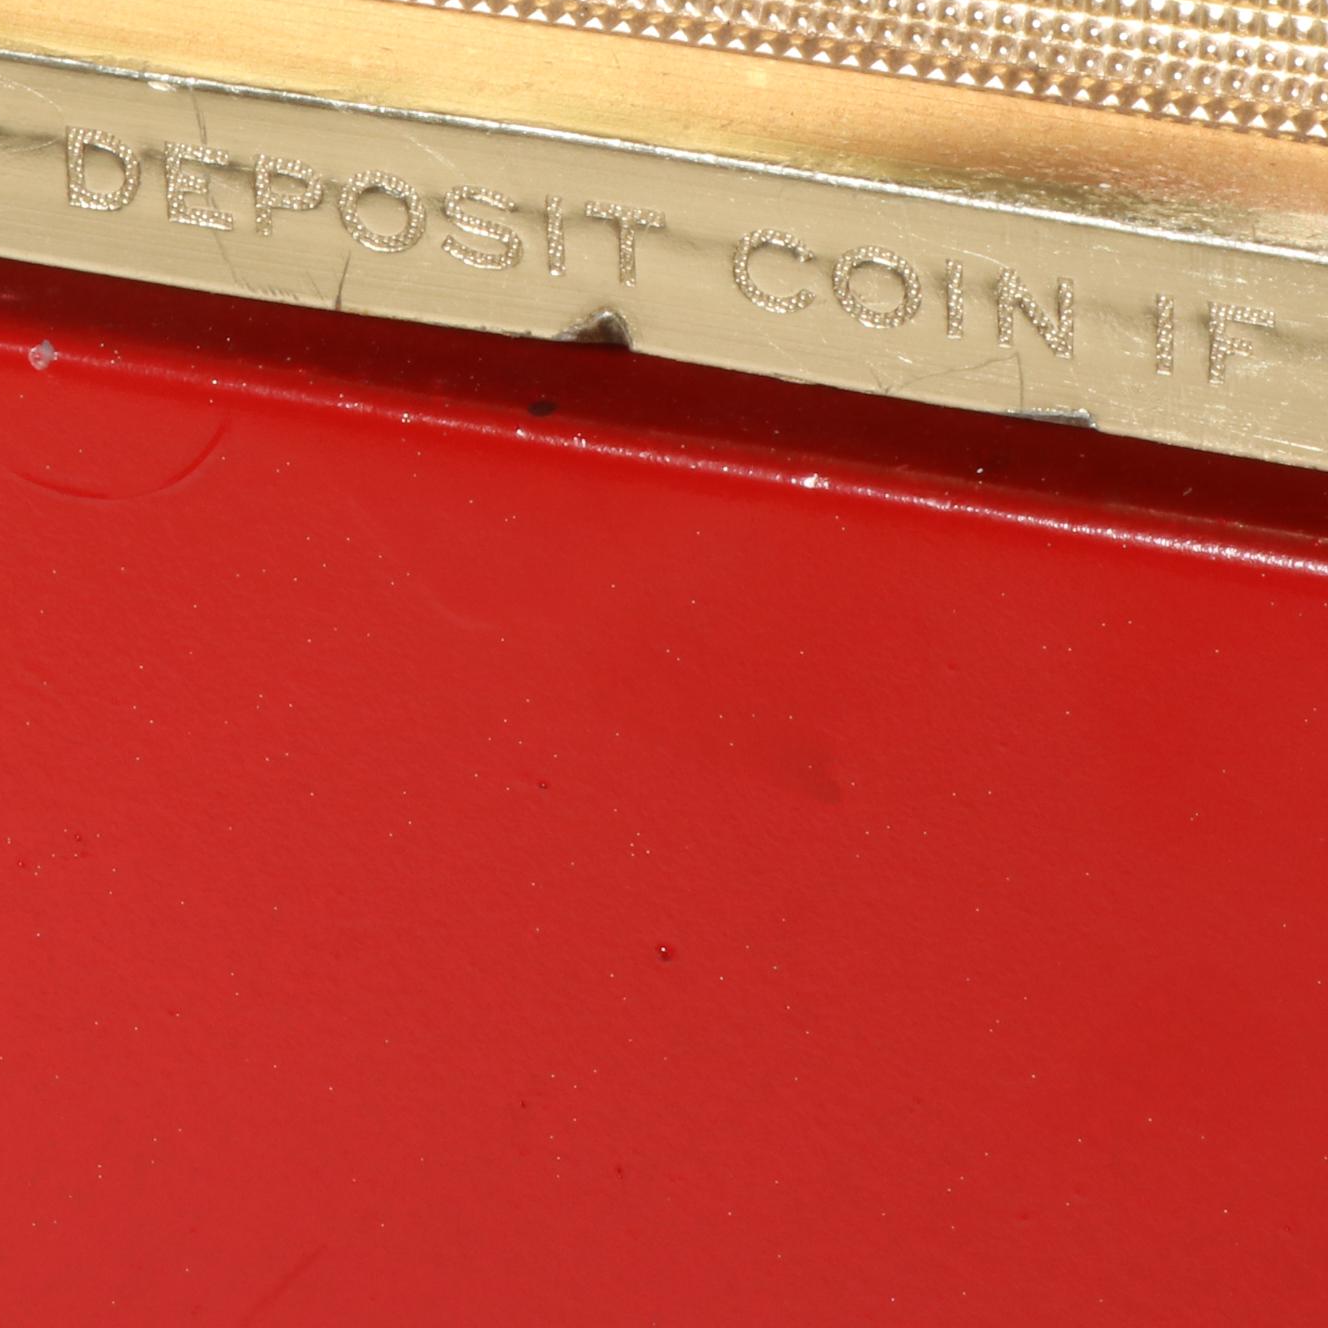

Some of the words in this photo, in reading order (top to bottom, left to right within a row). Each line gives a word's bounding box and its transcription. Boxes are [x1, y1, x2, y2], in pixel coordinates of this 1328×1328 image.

[66, 125, 666, 287] DEPOSIT
[733, 228, 1074, 360] COIN
[1155, 293, 1275, 384] IF
